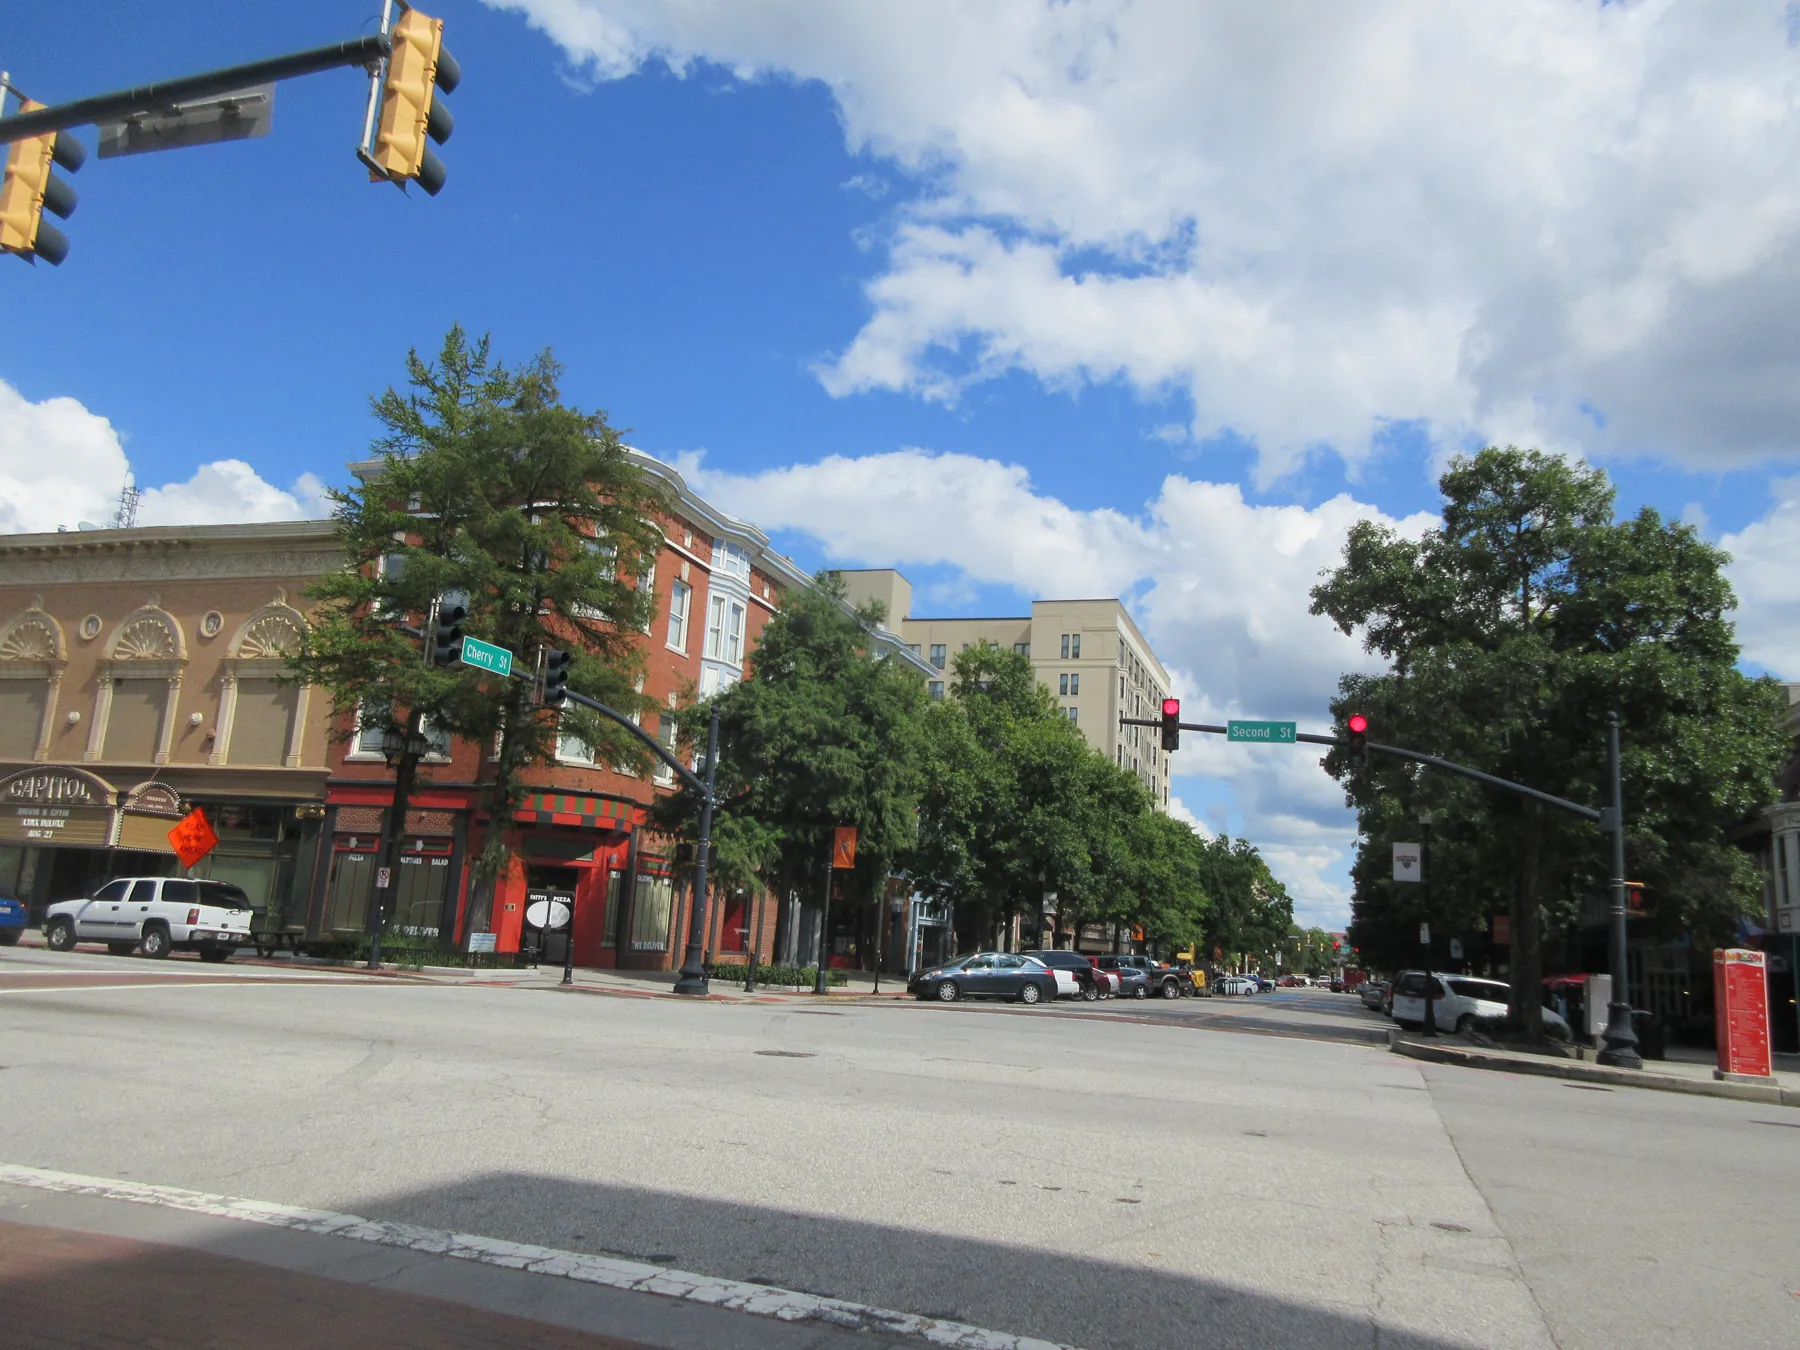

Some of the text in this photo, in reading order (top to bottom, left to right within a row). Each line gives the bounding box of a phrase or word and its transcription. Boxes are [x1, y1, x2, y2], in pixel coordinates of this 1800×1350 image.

[467, 644, 508, 669] Cherry St
[1232, 725, 1291, 738] Second St
[11, 776, 91, 799] CAPITOL
[185, 822, 204, 831] ROAD
[43, 830, 54, 838] 27
[431, 858, 449, 866] SALAD
[403, 925, 439, 937] DELIVER
